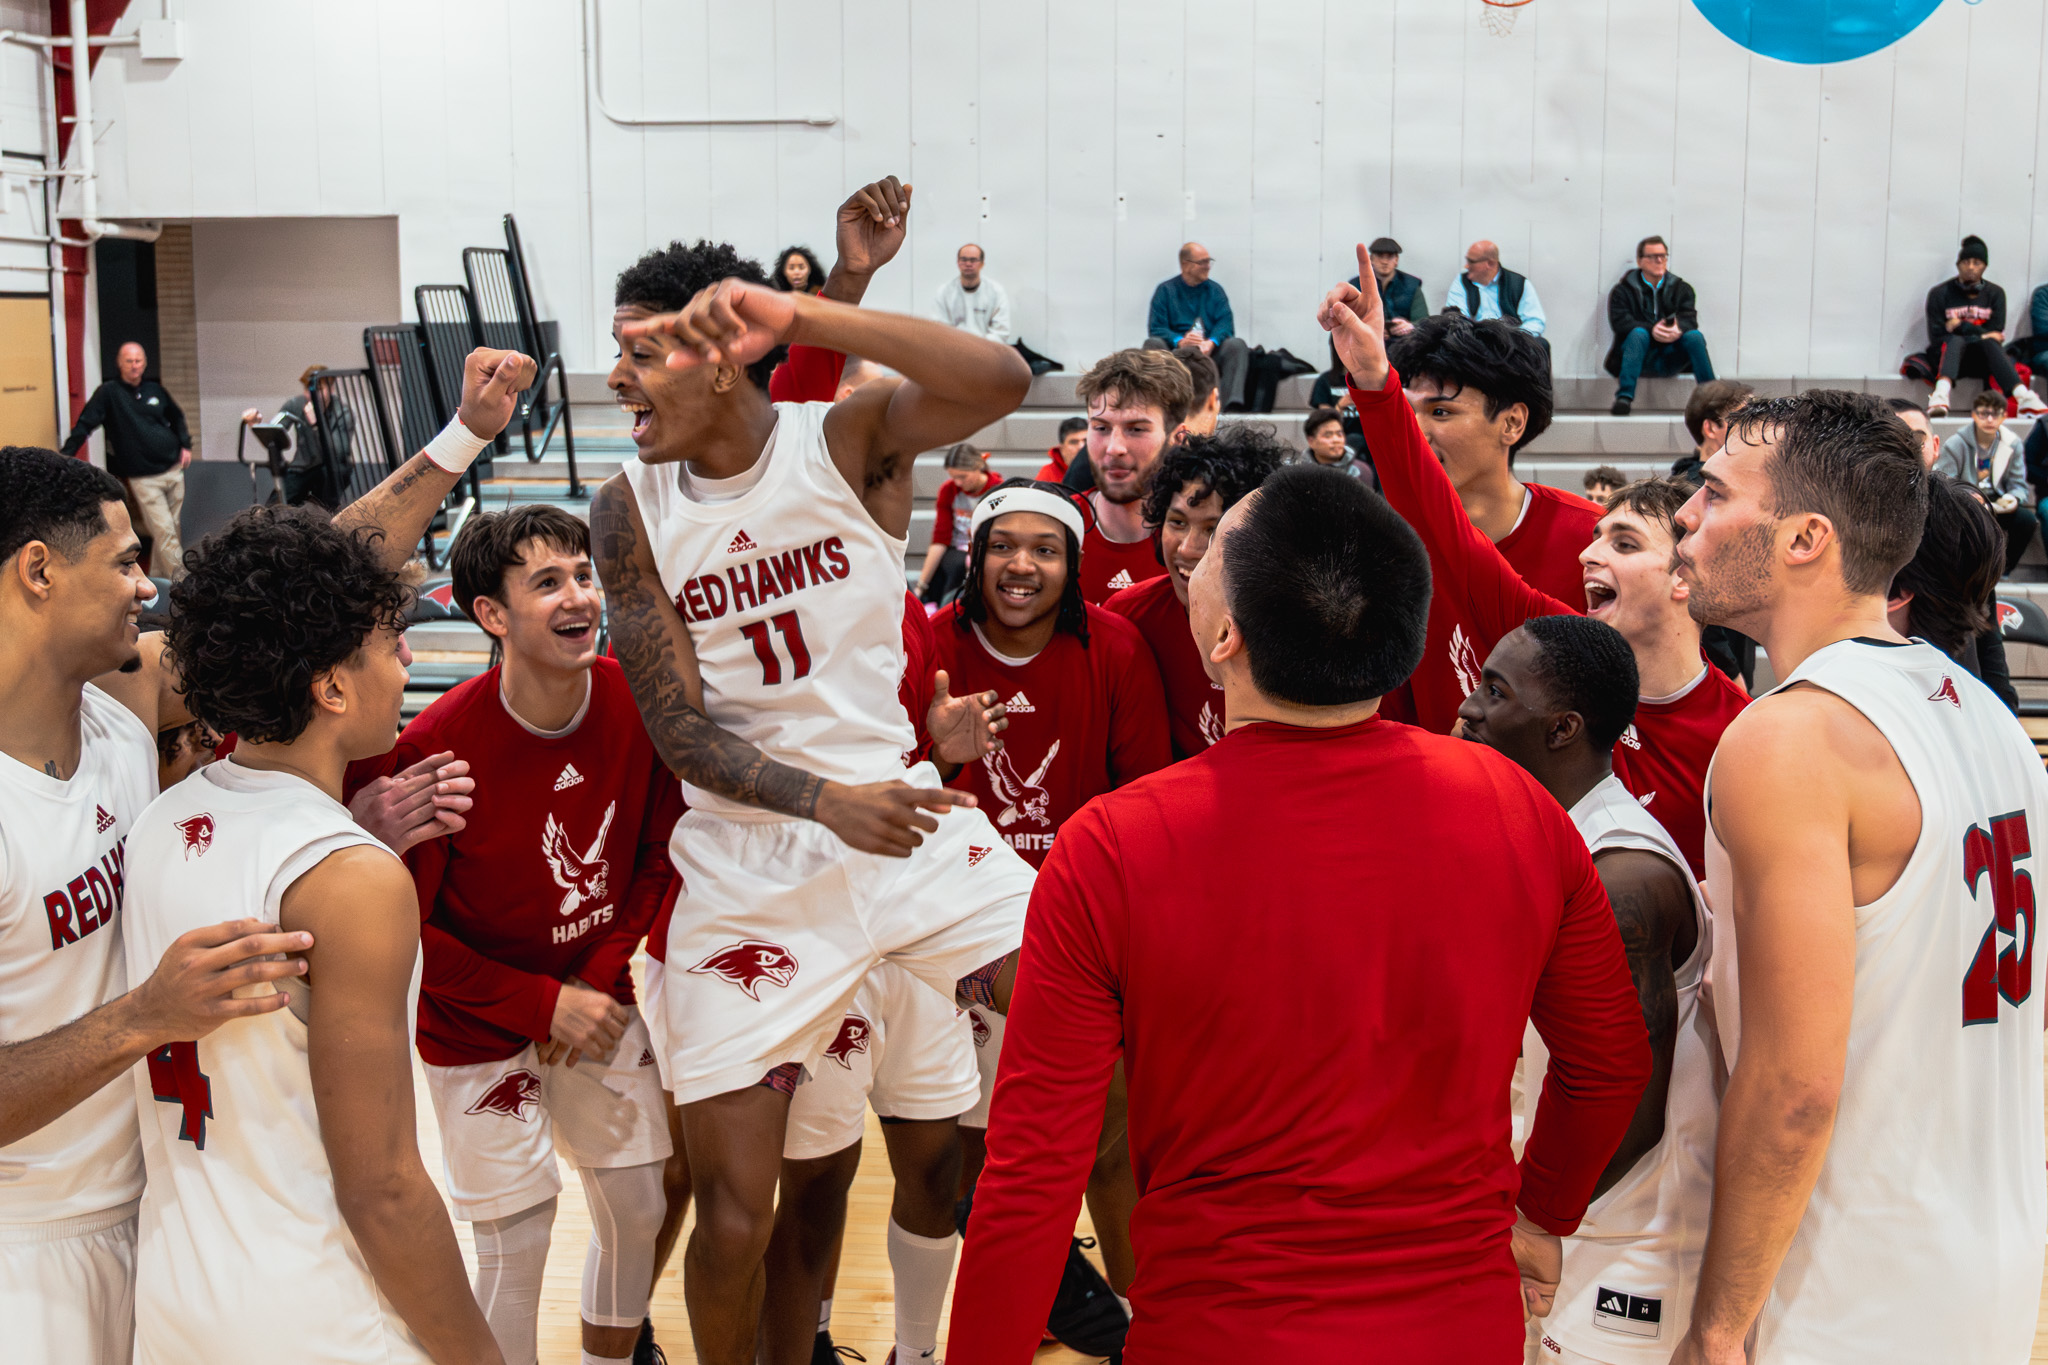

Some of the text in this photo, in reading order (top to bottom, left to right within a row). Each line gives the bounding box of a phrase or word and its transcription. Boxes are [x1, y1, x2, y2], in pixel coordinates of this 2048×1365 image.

[727, 541, 758, 554] adidas
[738, 609, 812, 686] 11
[554, 774, 585, 791] adidas
[97, 815, 116, 834] adidas
[1000, 832, 1056, 850] ABITS
[552, 903, 614, 944] HABITS
[1962, 808, 2036, 1028] 25
[1542, 1337, 1561, 1354] adidas
